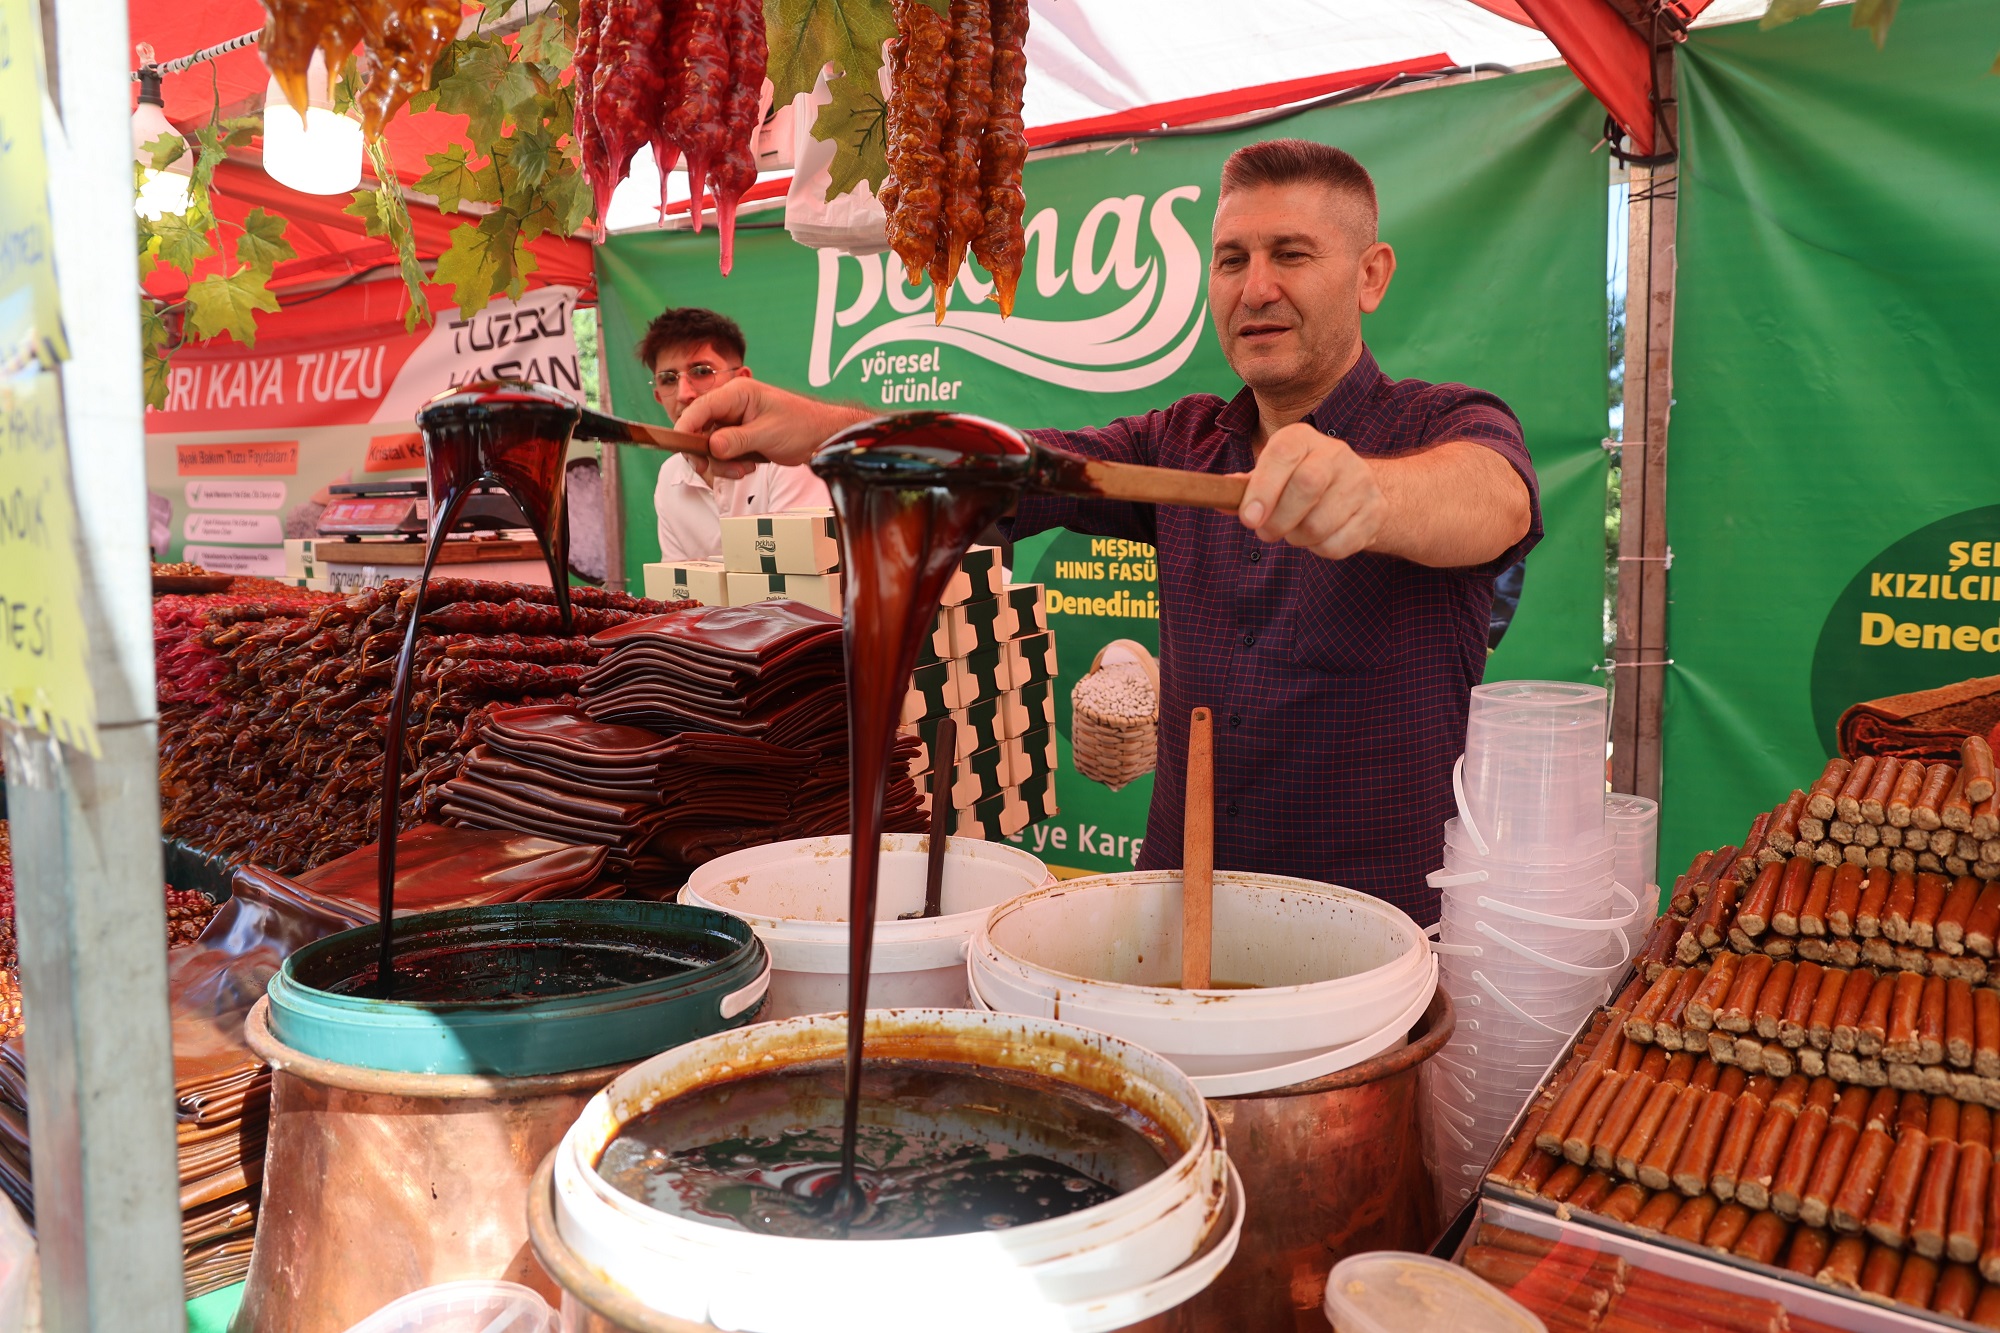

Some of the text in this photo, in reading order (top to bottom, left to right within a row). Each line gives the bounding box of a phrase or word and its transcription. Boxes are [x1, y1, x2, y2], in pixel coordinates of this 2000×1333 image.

[206, 357, 284, 410] KAYA
[296, 345, 386, 403] TUZU
[860, 346, 941, 383] yöresel
[881, 376, 962, 404] ürünler
[1055, 561, 1104, 580] HINIS
